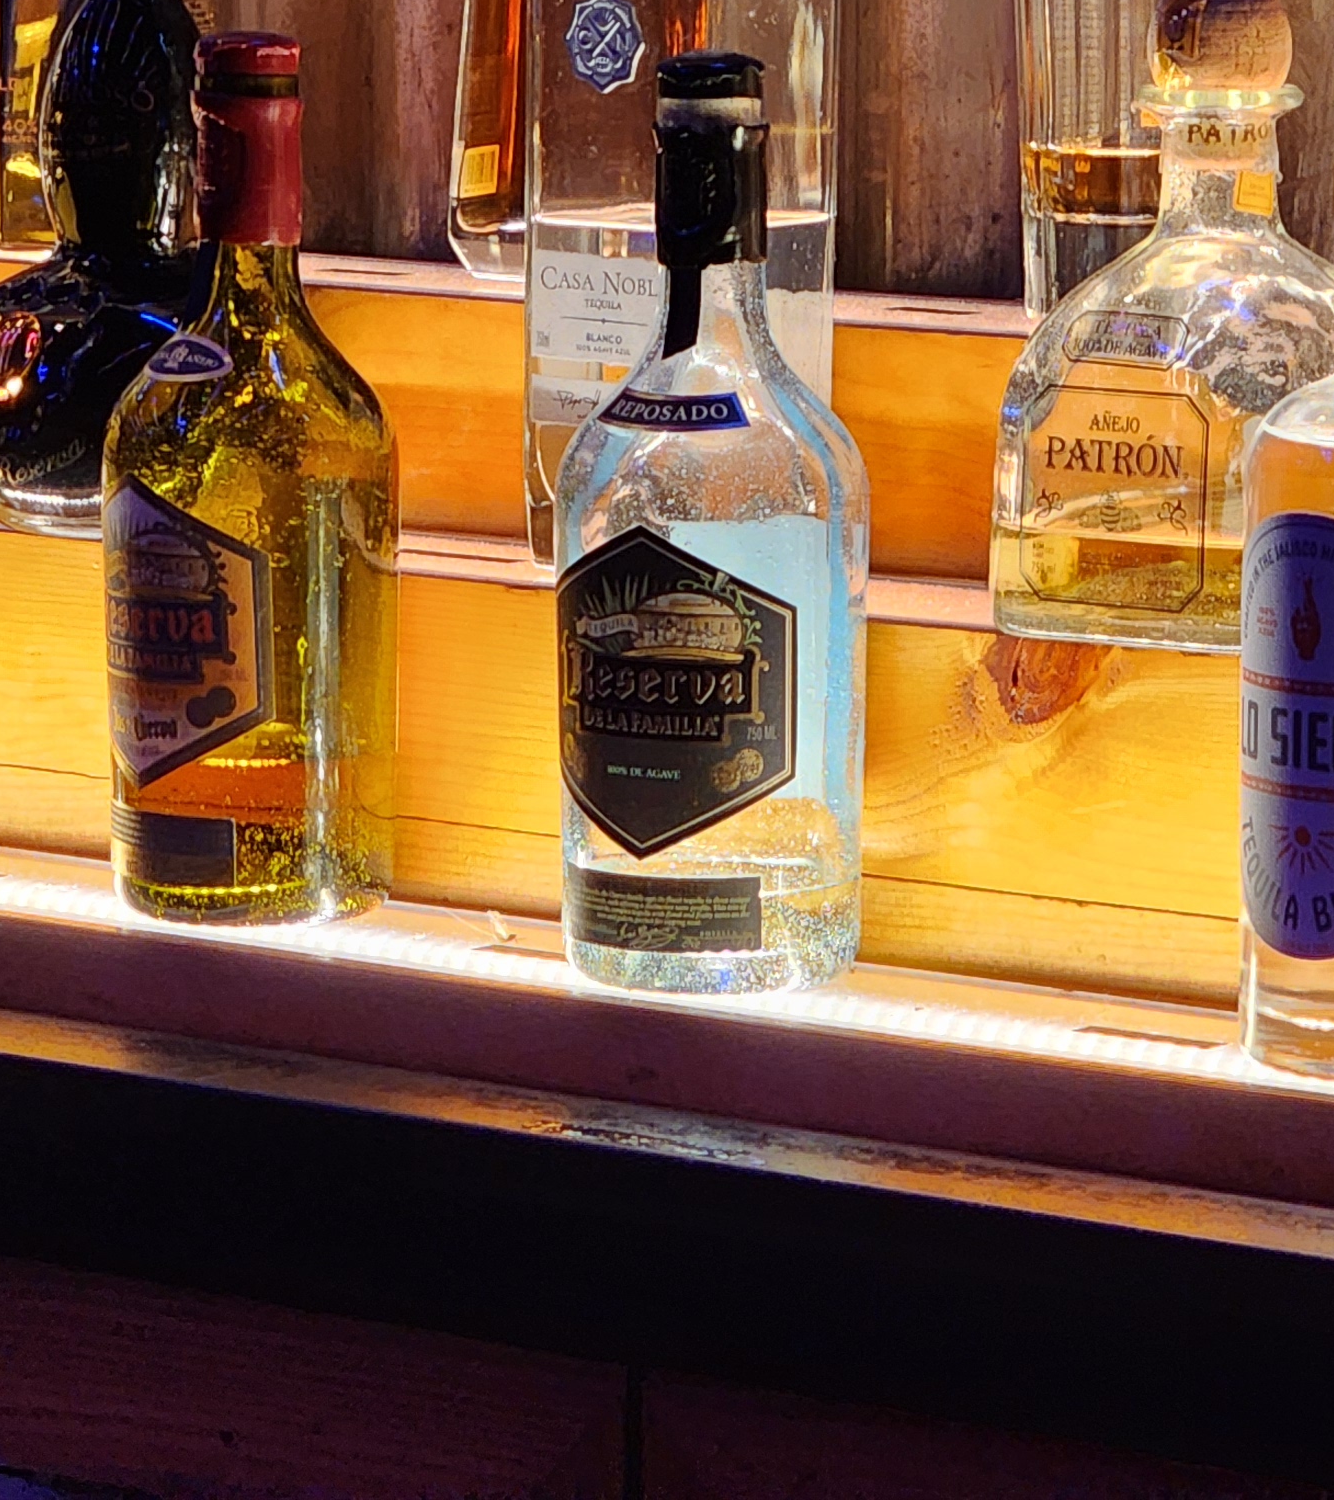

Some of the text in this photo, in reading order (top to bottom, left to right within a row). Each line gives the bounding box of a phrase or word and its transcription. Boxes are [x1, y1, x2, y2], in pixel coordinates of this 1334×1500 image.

[1187, 123, 1267, 144] PATRO
[541, 266, 658, 298] CASA NOBL
[584, 298, 622, 311] TEQUILA
[586, 332, 622, 345] BLANCO
[612, 399, 728, 423] REPOSADO
[1089, 410, 1140, 434] AÑEJO
[1044, 434, 1185, 479] PATRÓN
[587, 618, 636, 636] TEQUILA
[579, 649, 746, 705] Reserva
[645, 767, 681, 781] AGAVE
[1243, 816, 1299, 931] TEQUILA
